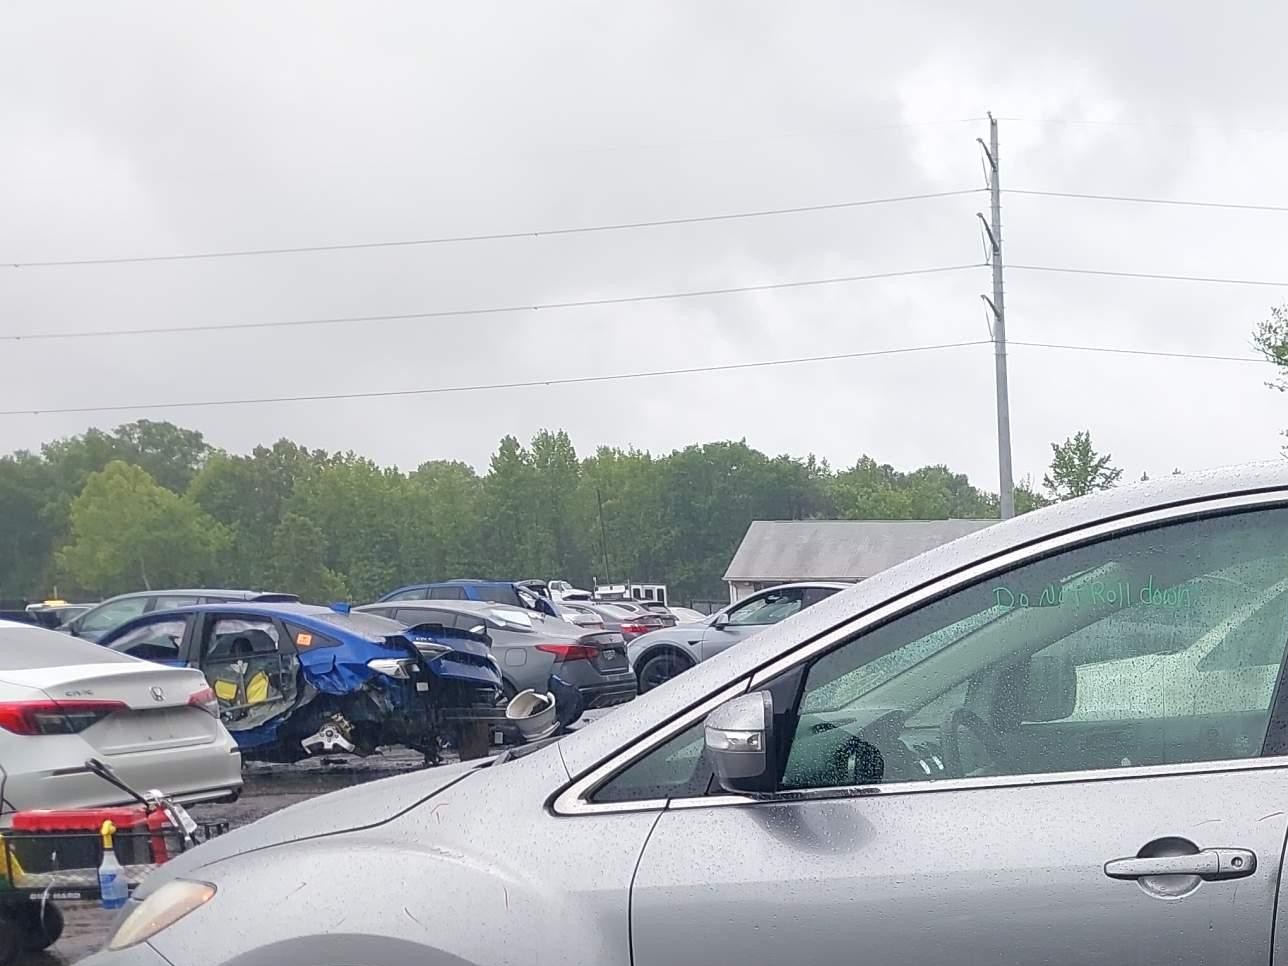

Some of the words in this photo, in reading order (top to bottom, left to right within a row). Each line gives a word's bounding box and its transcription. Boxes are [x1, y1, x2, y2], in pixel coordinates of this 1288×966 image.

[992, 586, 1029, 609] Do
[1091, 581, 1131, 608] Roll
[1140, 574, 1191, 608] down
